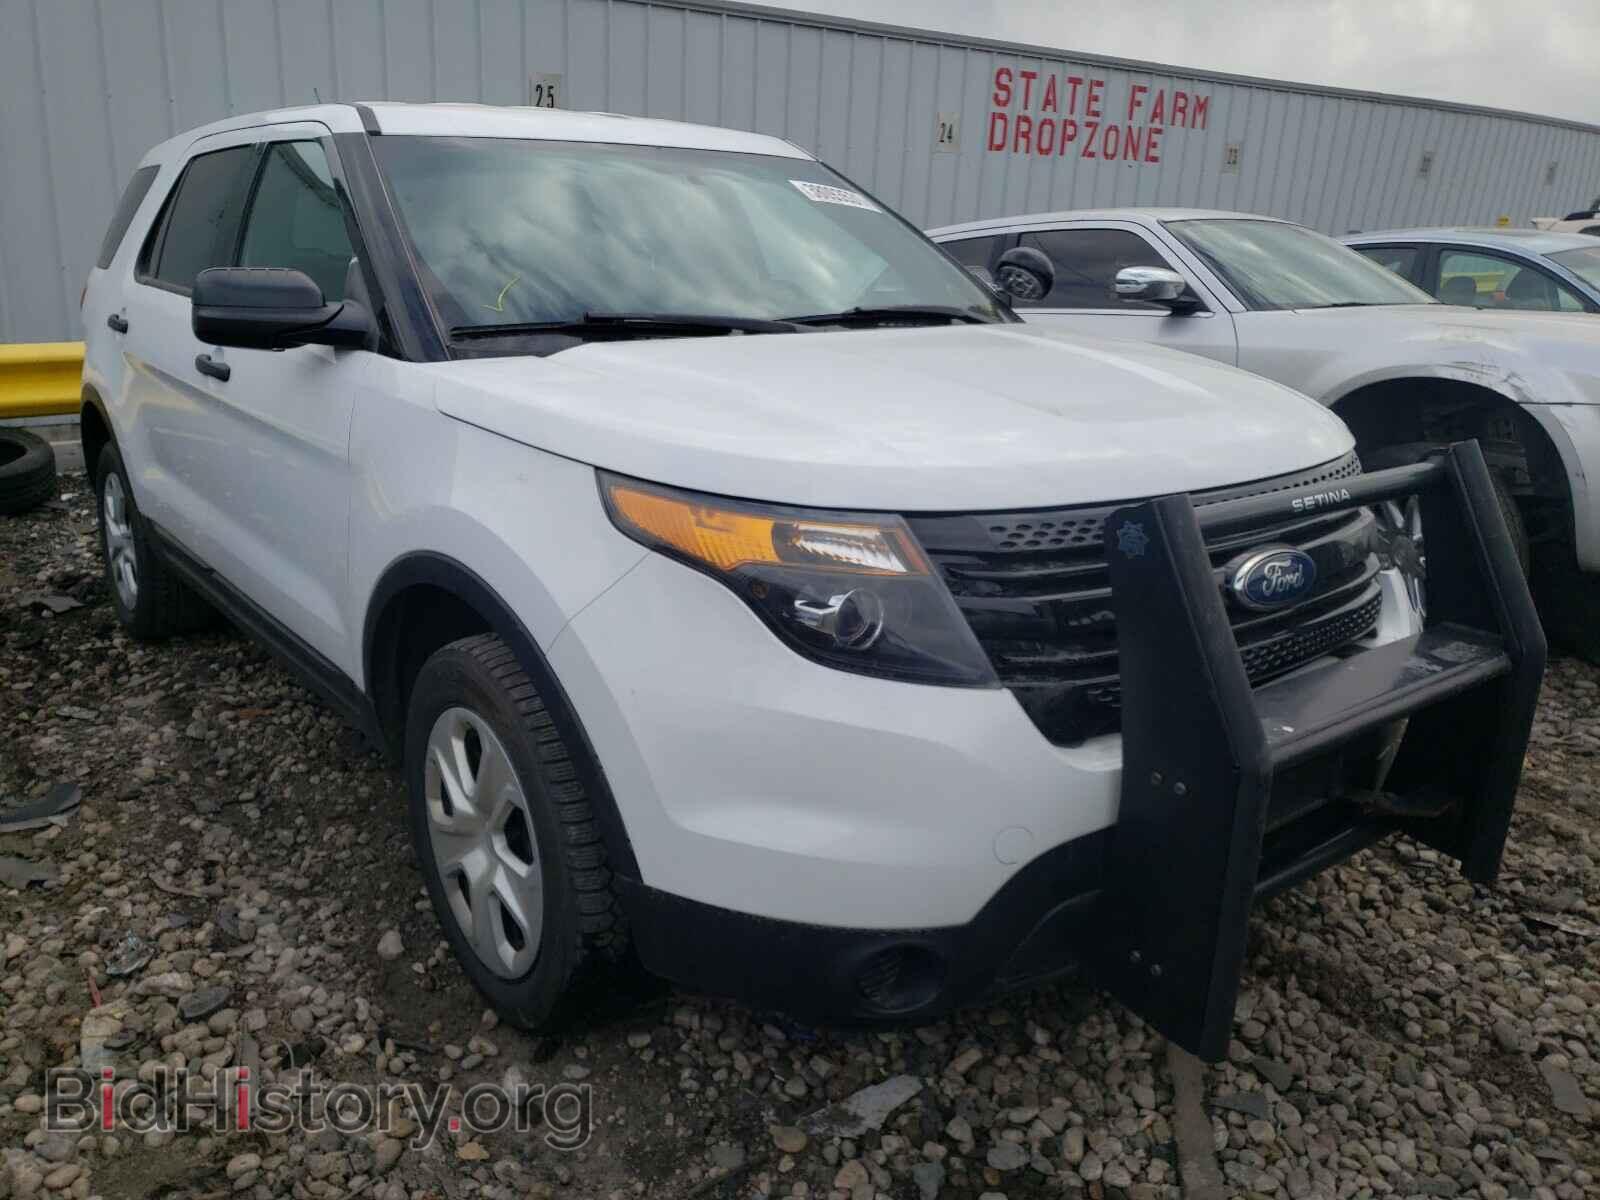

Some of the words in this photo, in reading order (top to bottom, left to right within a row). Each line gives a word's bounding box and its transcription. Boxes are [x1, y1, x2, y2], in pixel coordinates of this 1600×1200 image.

[535, 83, 555, 108] 25
[992, 67, 1105, 118] STATE
[1127, 84, 1209, 130] FARM
[938, 121, 954, 144] 24
[987, 111, 1163, 163] DROPZONE
[1291, 488, 1351, 512] SETINA
[1262, 559, 1304, 597] Ford
